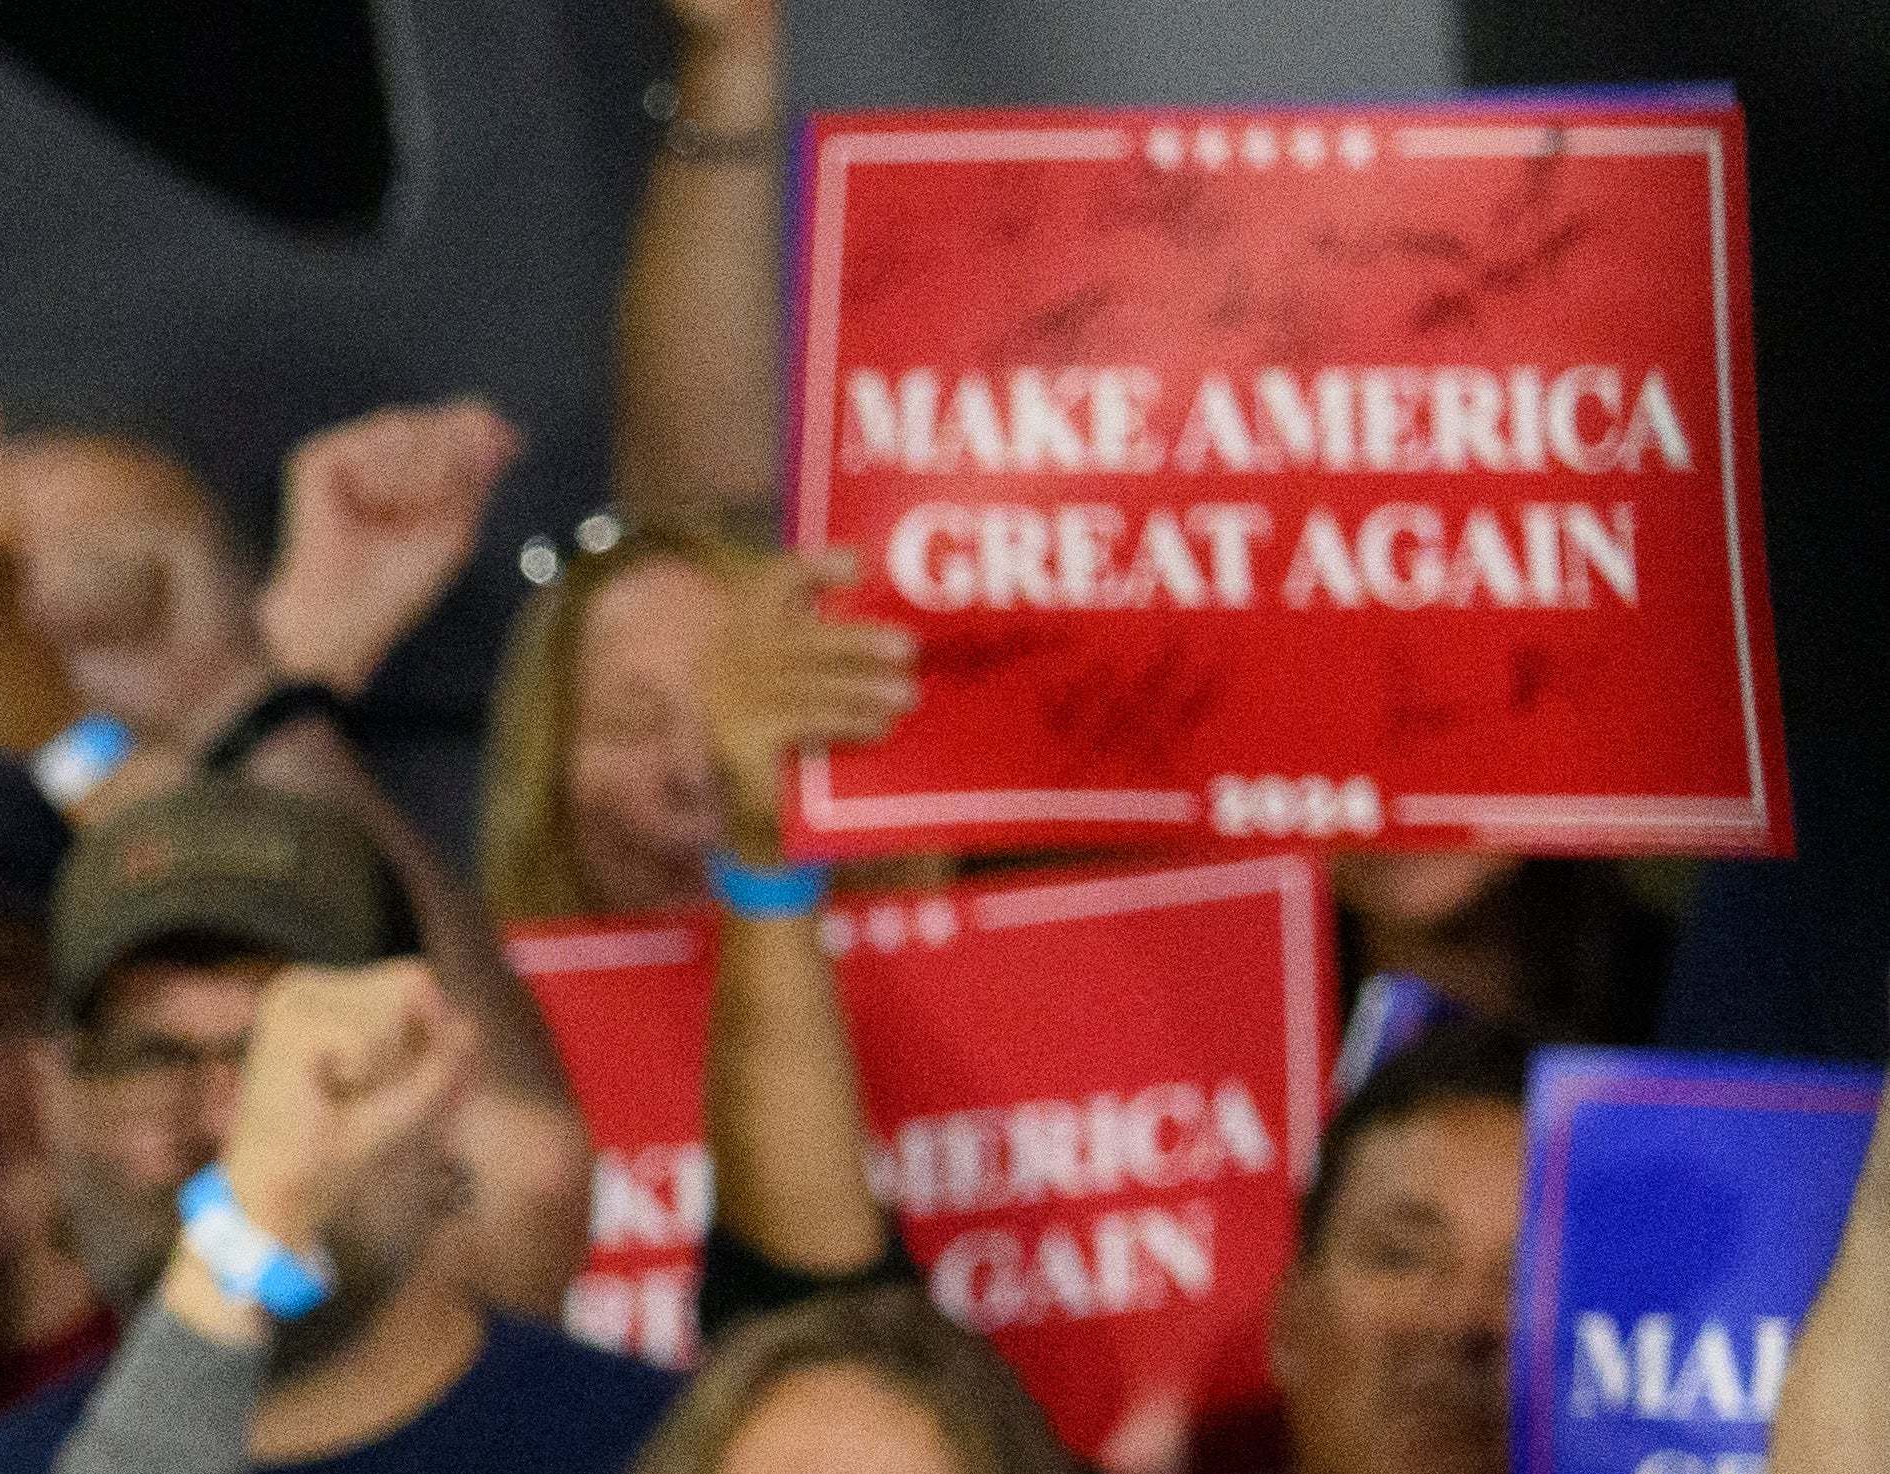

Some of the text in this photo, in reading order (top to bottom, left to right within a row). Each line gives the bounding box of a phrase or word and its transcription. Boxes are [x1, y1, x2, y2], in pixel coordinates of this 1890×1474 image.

[842, 362, 1696, 475] MAKE AMERICA
[885, 501, 1640, 610] GREAT AGAIN
[867, 1078, 1277, 1216] MERICA
[929, 1203, 1215, 1334] GAIN
[1573, 1310, 1792, 1424] MA
